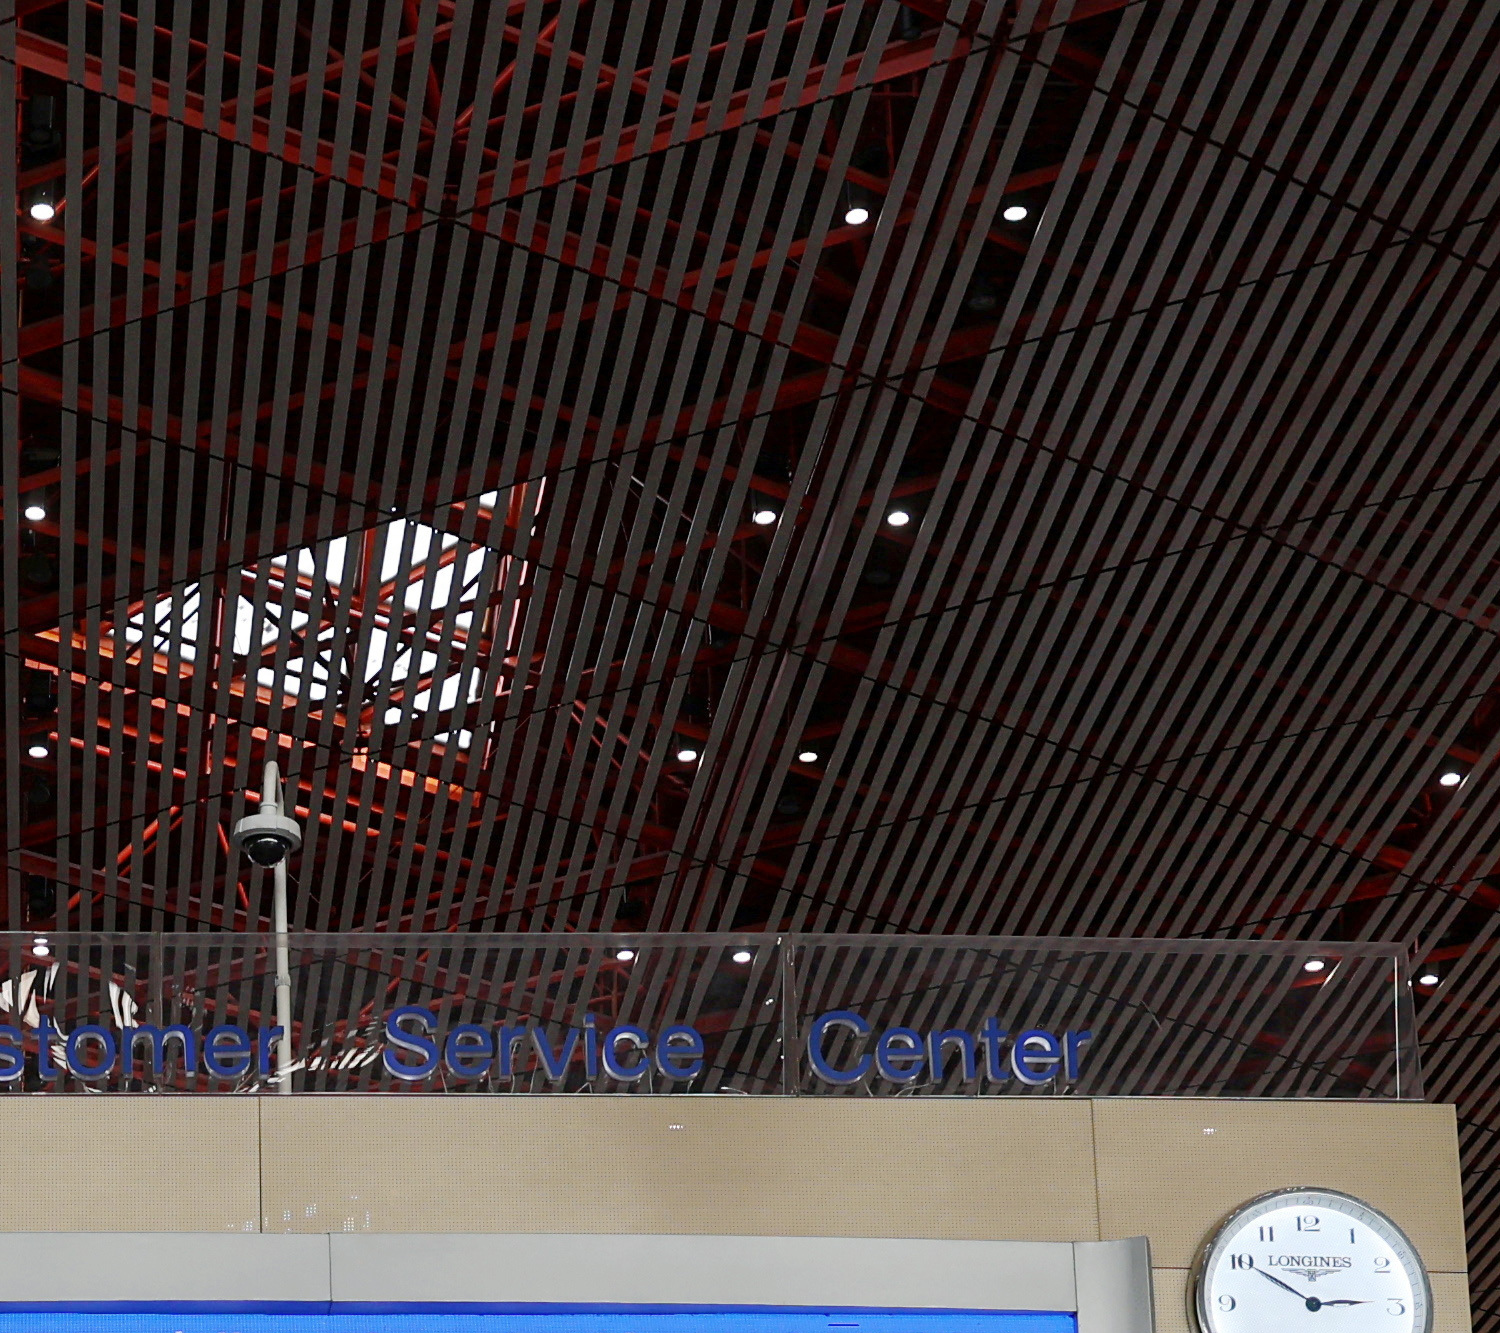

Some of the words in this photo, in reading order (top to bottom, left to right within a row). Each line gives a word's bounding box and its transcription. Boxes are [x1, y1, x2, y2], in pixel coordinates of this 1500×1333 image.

[382, 1002, 706, 1087] Service
[807, 1008, 1094, 1090] Center
[1268, 1255, 1352, 1268] LONGINES
